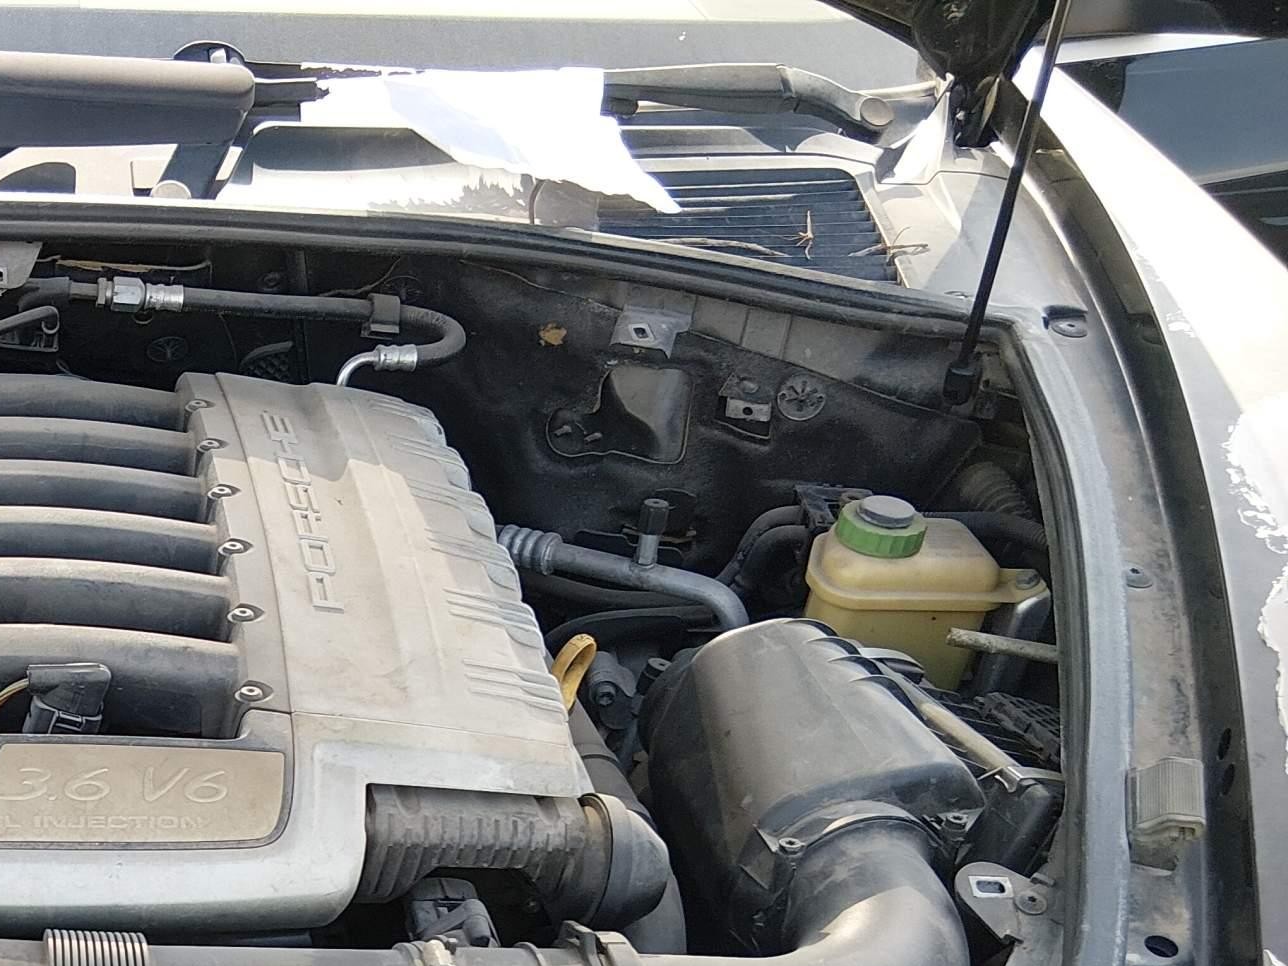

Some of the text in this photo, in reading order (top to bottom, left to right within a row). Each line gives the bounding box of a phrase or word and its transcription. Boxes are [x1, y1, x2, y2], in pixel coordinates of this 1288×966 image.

[261, 410, 344, 613] PORSCHE
[143, 767, 228, 803] V6
[34, 815, 203, 830] INJECTION
